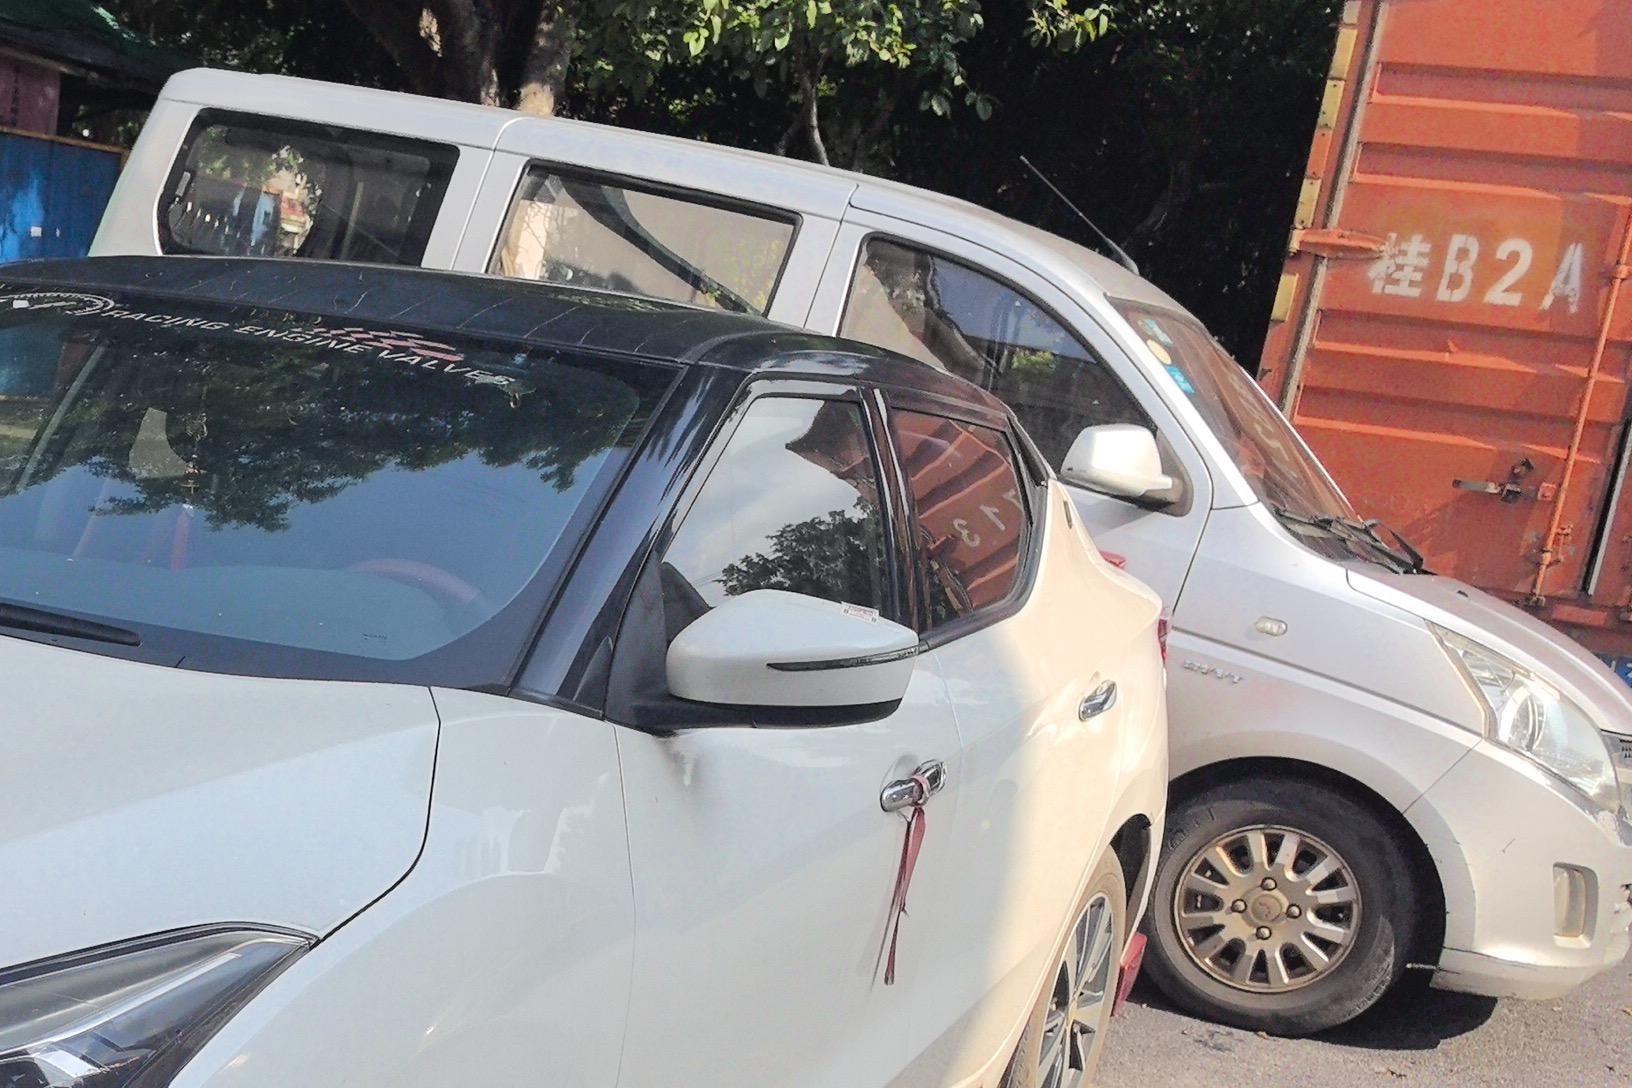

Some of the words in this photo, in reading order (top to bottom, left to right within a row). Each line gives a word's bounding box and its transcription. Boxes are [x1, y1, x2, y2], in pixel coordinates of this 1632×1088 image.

[101, 309, 229, 331] RACING
[234, 325, 366, 354] ENGINE
[378, 349, 516, 386] VALVES
